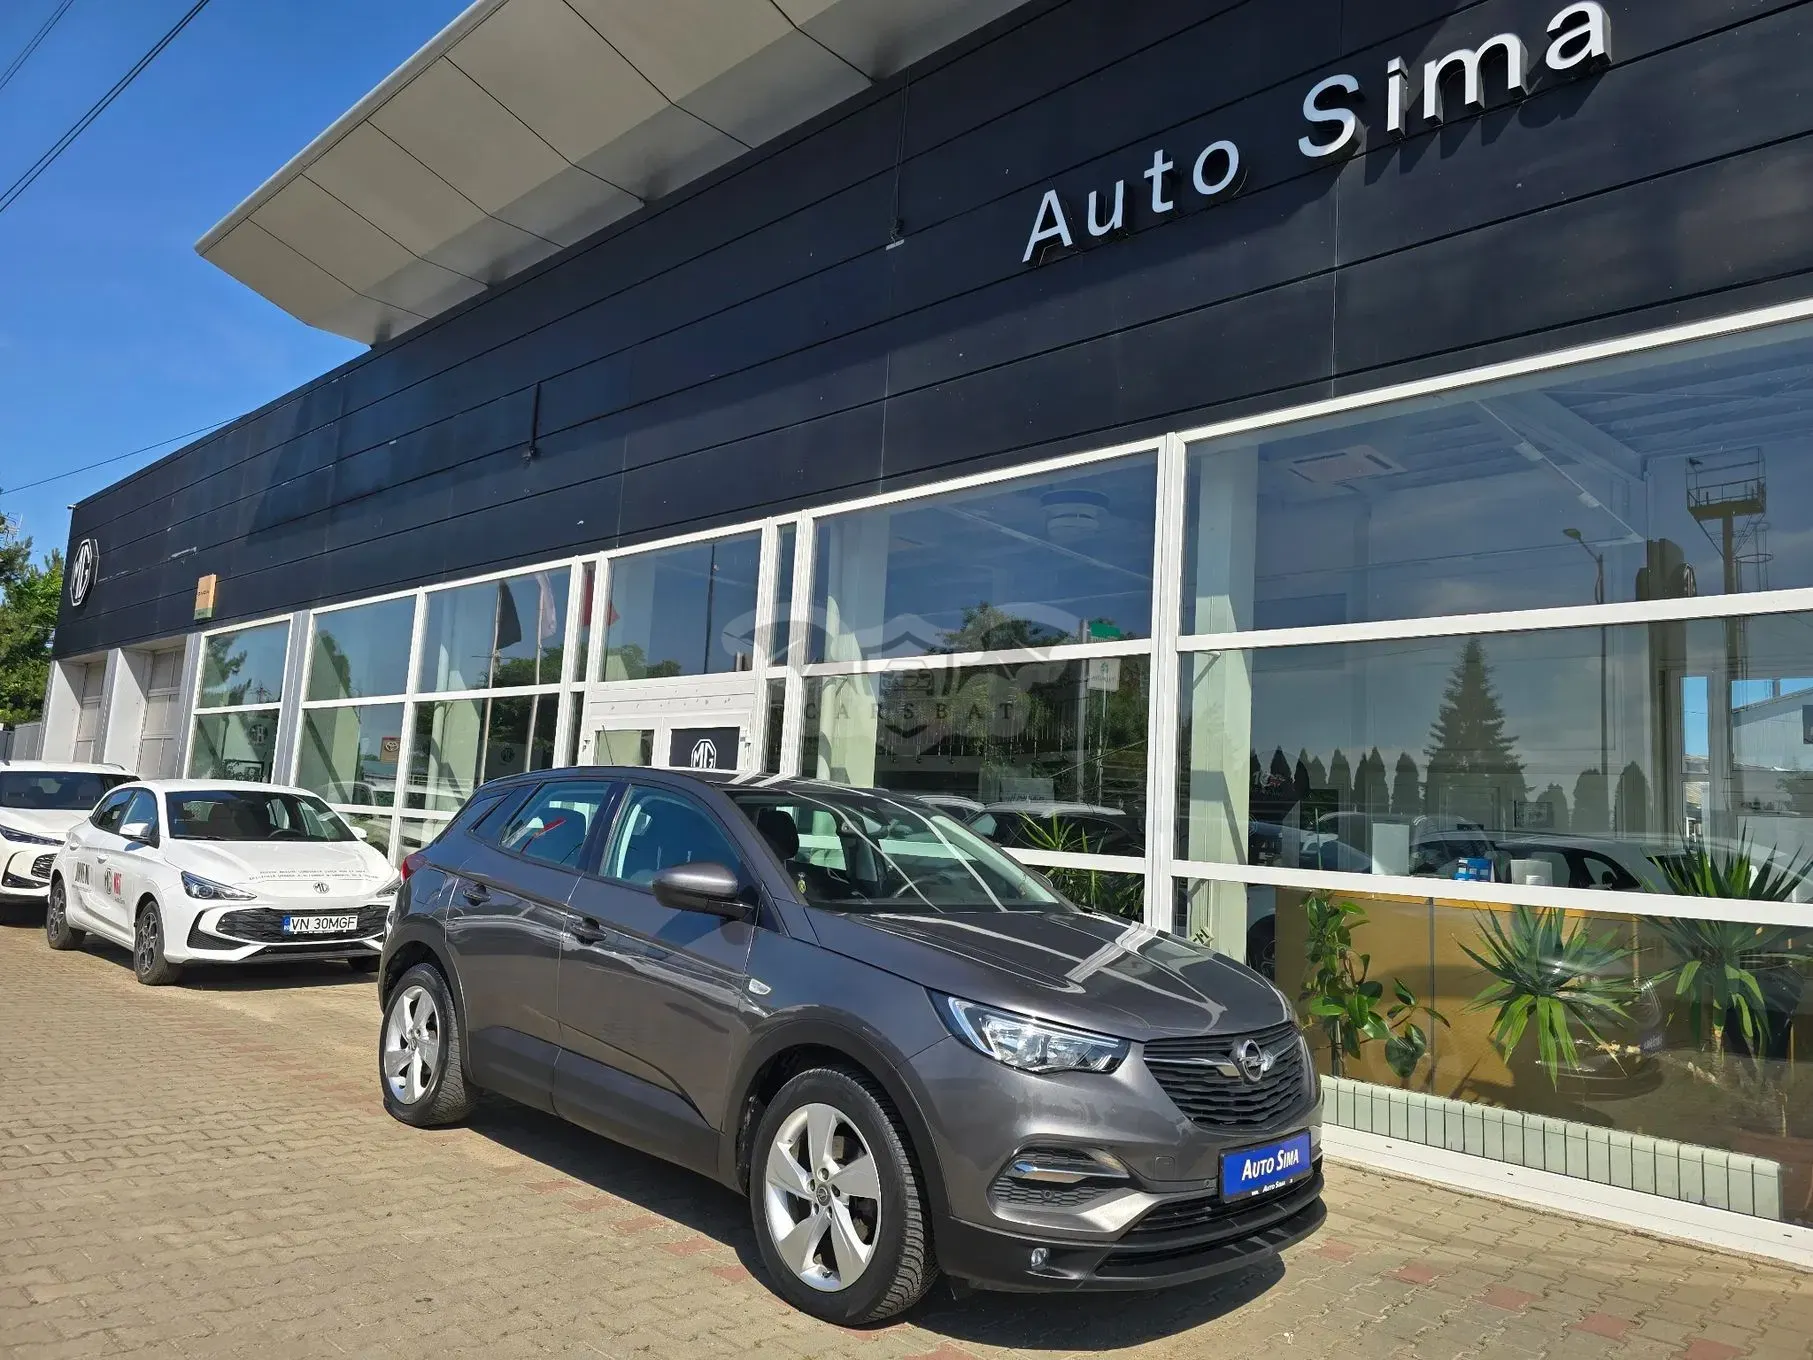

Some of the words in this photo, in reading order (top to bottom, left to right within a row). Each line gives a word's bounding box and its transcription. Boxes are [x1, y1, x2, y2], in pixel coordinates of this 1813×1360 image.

[1022, 139, 1241, 263] Auto
[1298, 0, 1612, 158] Sima
[71, 540, 92, 604] MG
[692, 741, 715, 769] MG
[291, 918, 310, 931] VN
[313, 916, 357, 930] 30MGF
[1241, 1157, 1275, 1181] AUTO
[1276, 1149, 1300, 1171] SIMA
